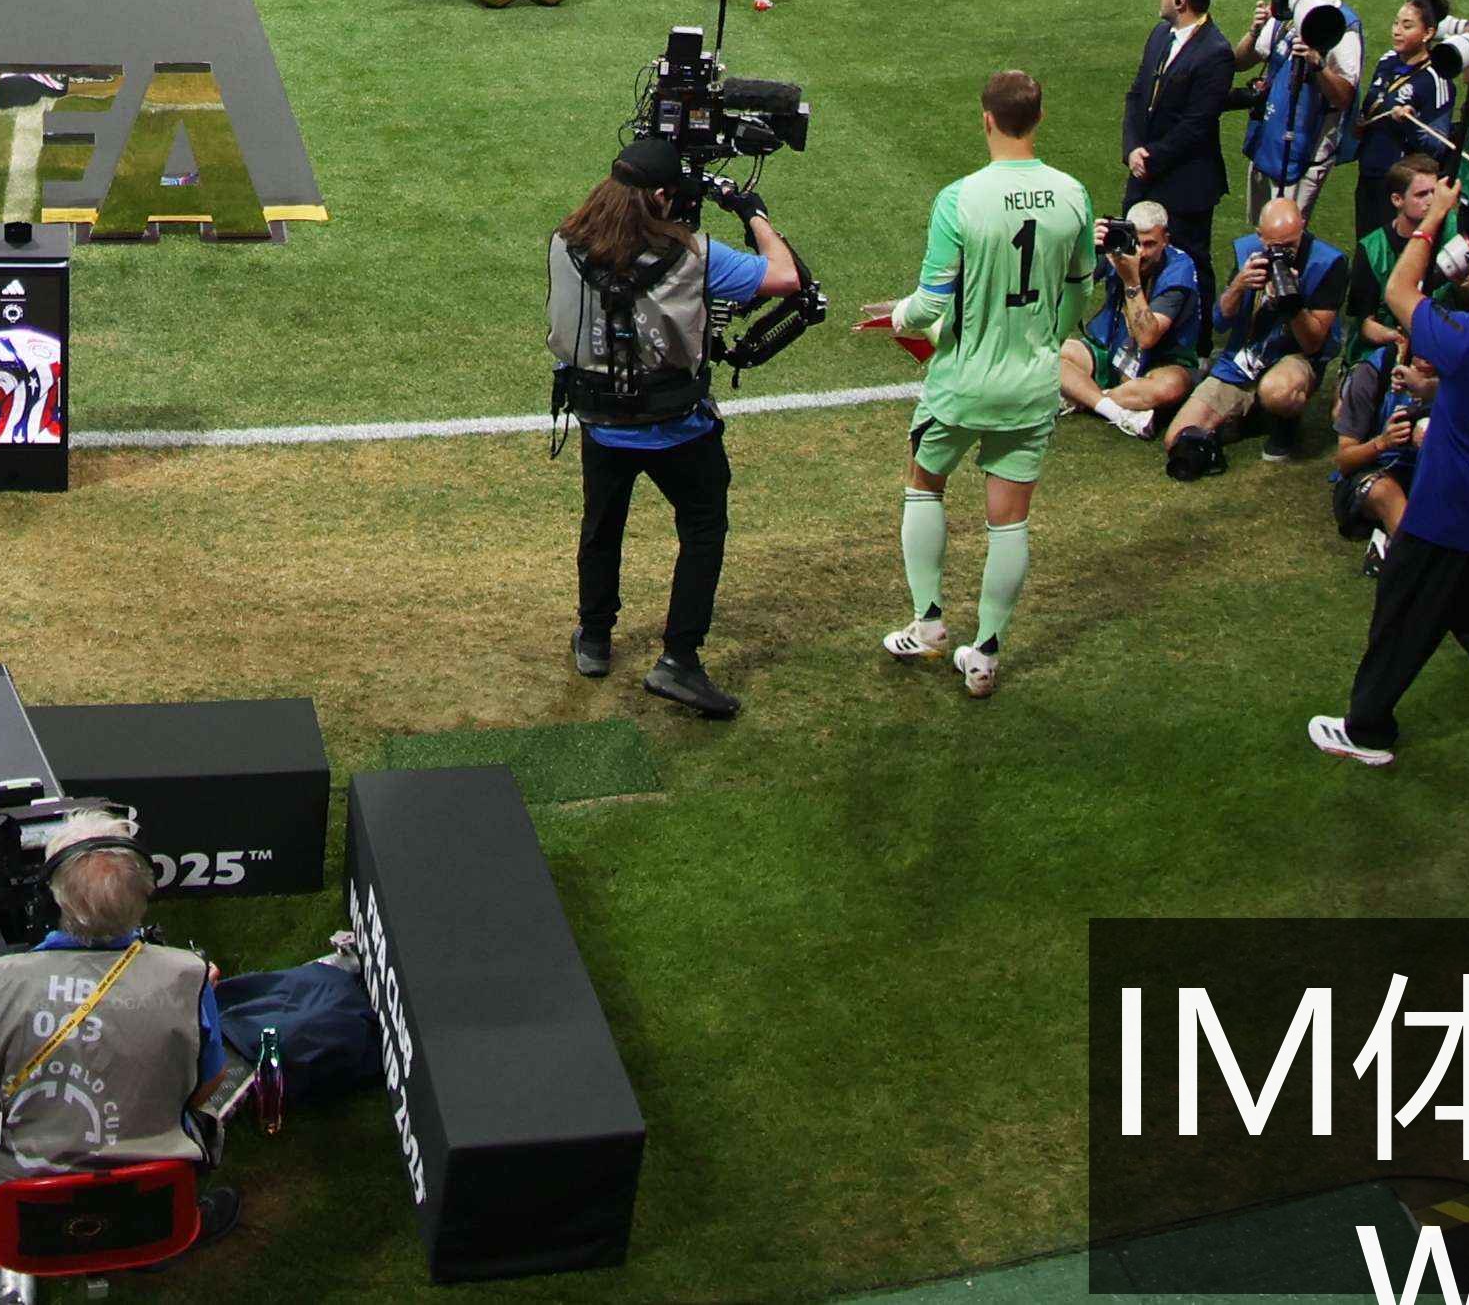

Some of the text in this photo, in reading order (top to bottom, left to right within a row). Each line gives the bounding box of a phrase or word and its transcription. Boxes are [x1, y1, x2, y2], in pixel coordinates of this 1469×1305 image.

[1004, 190, 1055, 211] NEUER
[1005, 219, 1040, 307] 1
[368, 884, 413, 1079] FIFA CLUB
[103, 1101, 120, 1146] CUP
